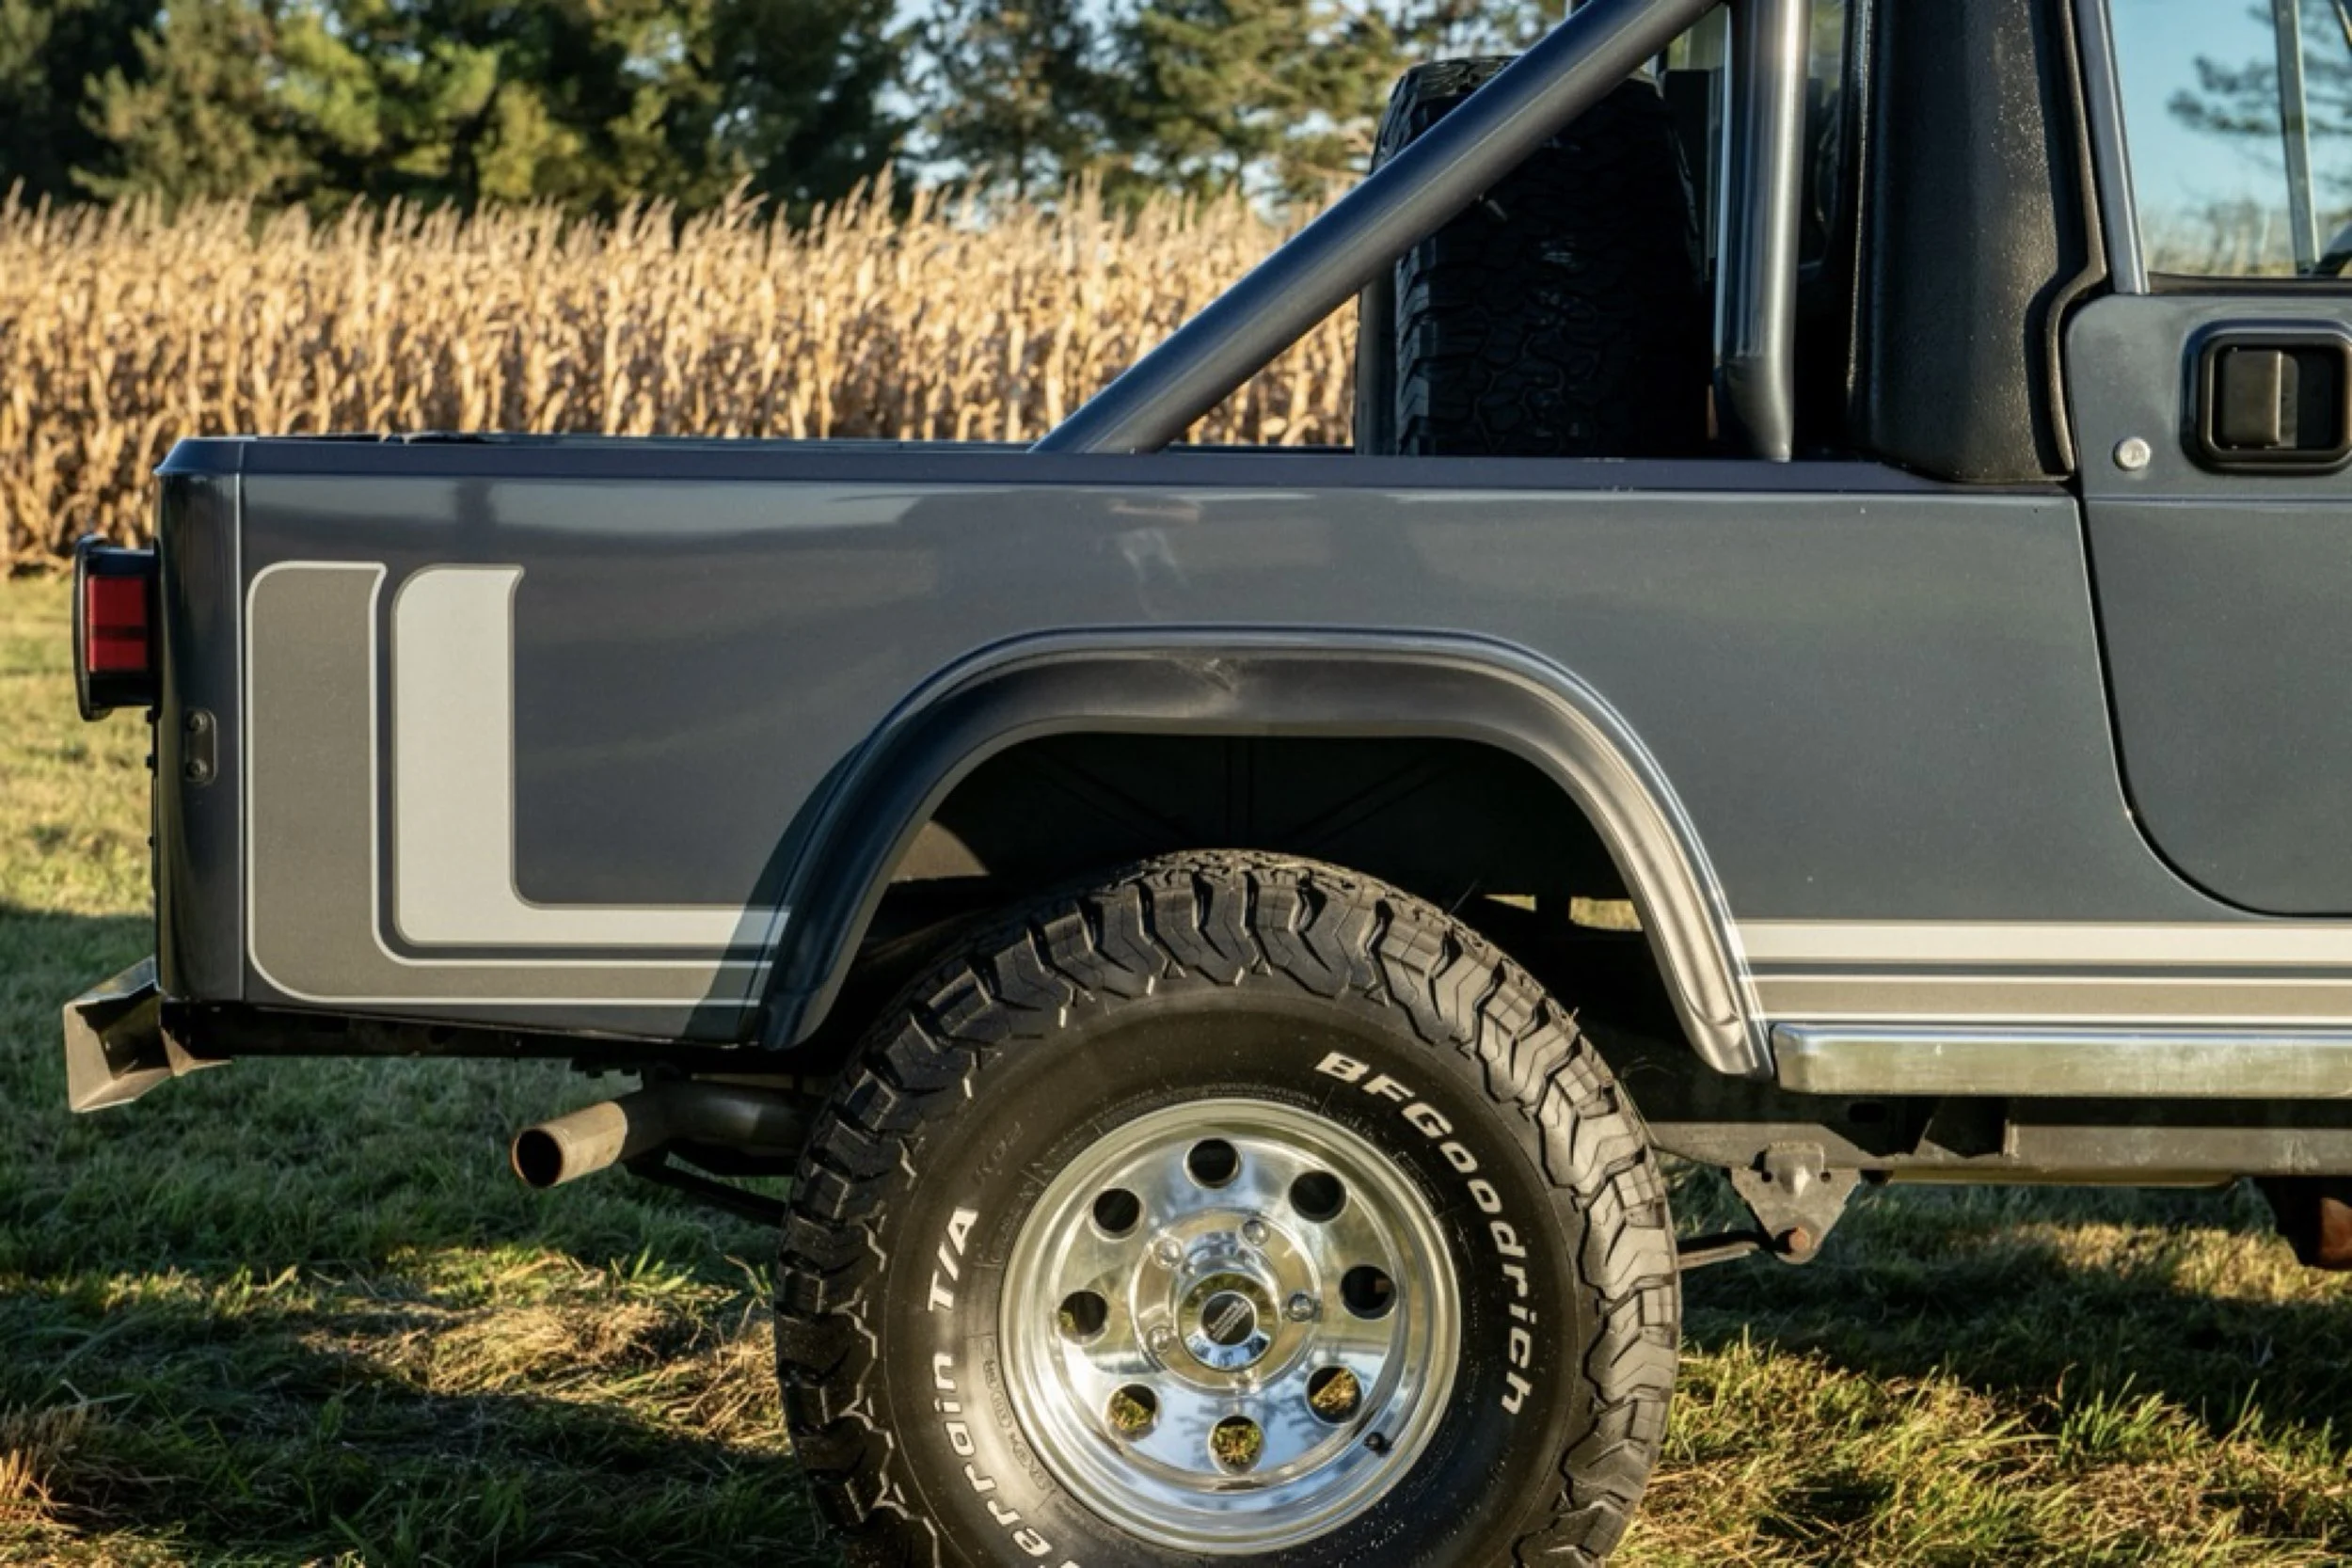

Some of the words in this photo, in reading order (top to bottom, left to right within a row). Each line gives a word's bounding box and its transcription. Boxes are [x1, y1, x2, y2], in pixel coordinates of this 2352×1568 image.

[928, 1206, 978, 1311] T/A
[1315, 1052, 1537, 1415] BFGoodrich
[934, 1353, 1080, 1568] errain
